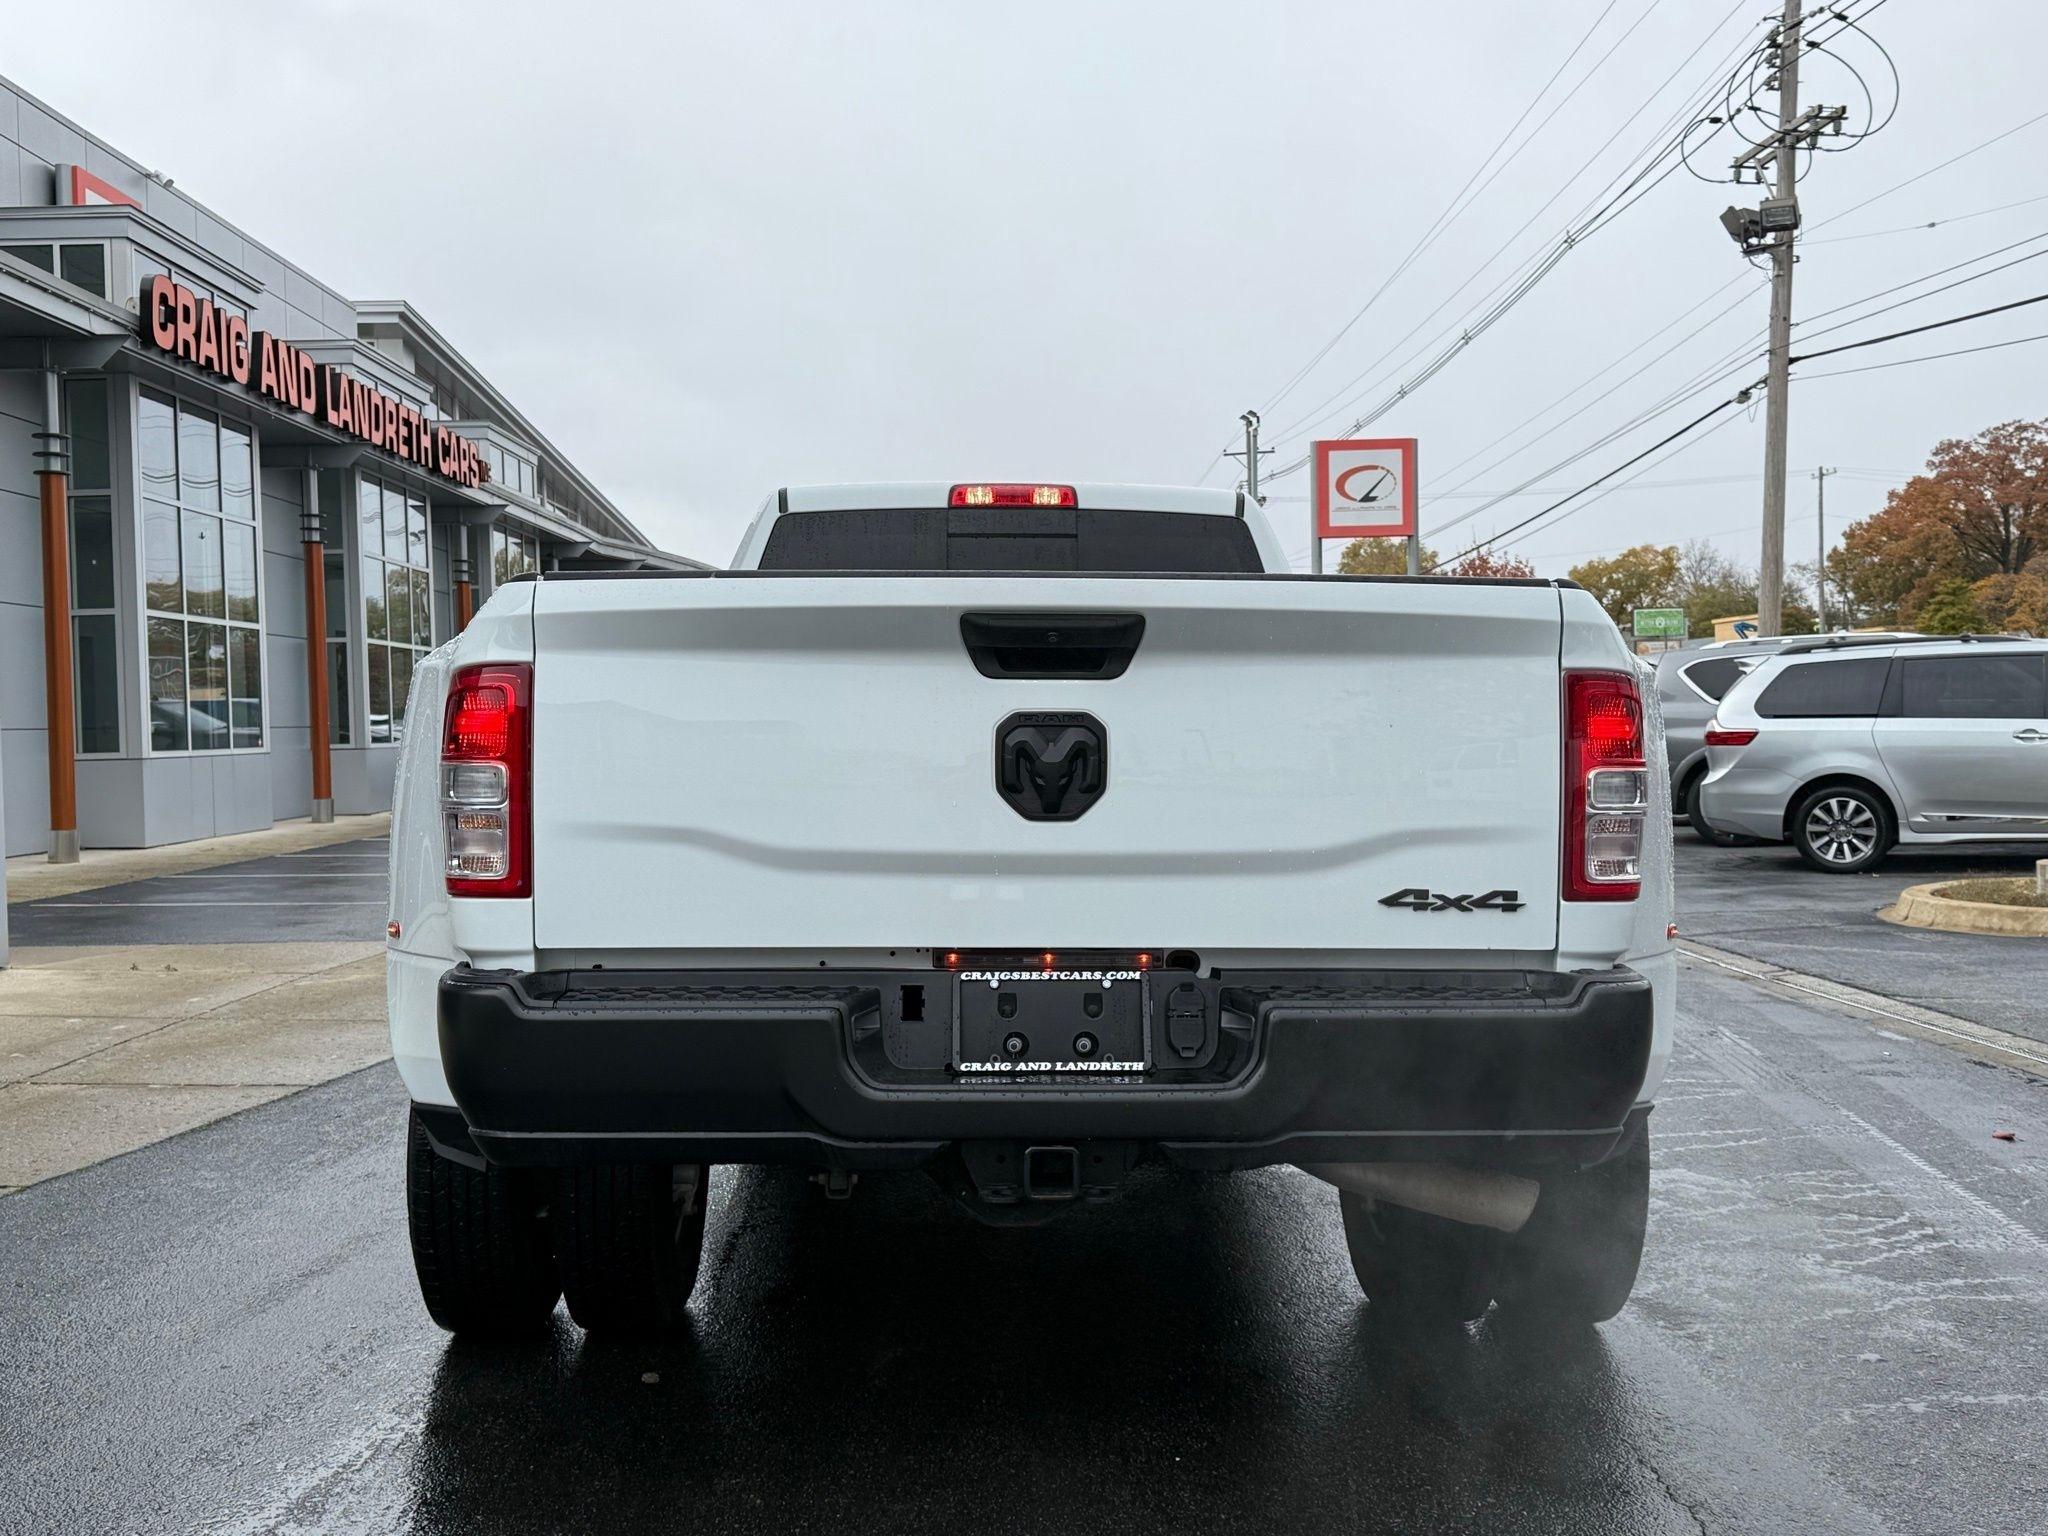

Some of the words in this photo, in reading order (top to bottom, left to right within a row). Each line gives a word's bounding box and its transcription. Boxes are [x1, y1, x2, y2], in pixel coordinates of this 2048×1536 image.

[151, 274, 250, 385] CRAIG
[259, 331, 317, 415] AND
[325, 364, 433, 469] LANDRETH
[437, 424, 480, 489] CARS
[1018, 713, 1085, 723] RAM
[1377, 888, 1528, 912] 4x4
[960, 970, 1141, 980] CRAIGSBESTCARS.COM
[960, 1062, 1012, 1071] CRAIG
[1015, 1062, 1052, 1071] AND
[1055, 1062, 1145, 1071] LANDRETH
